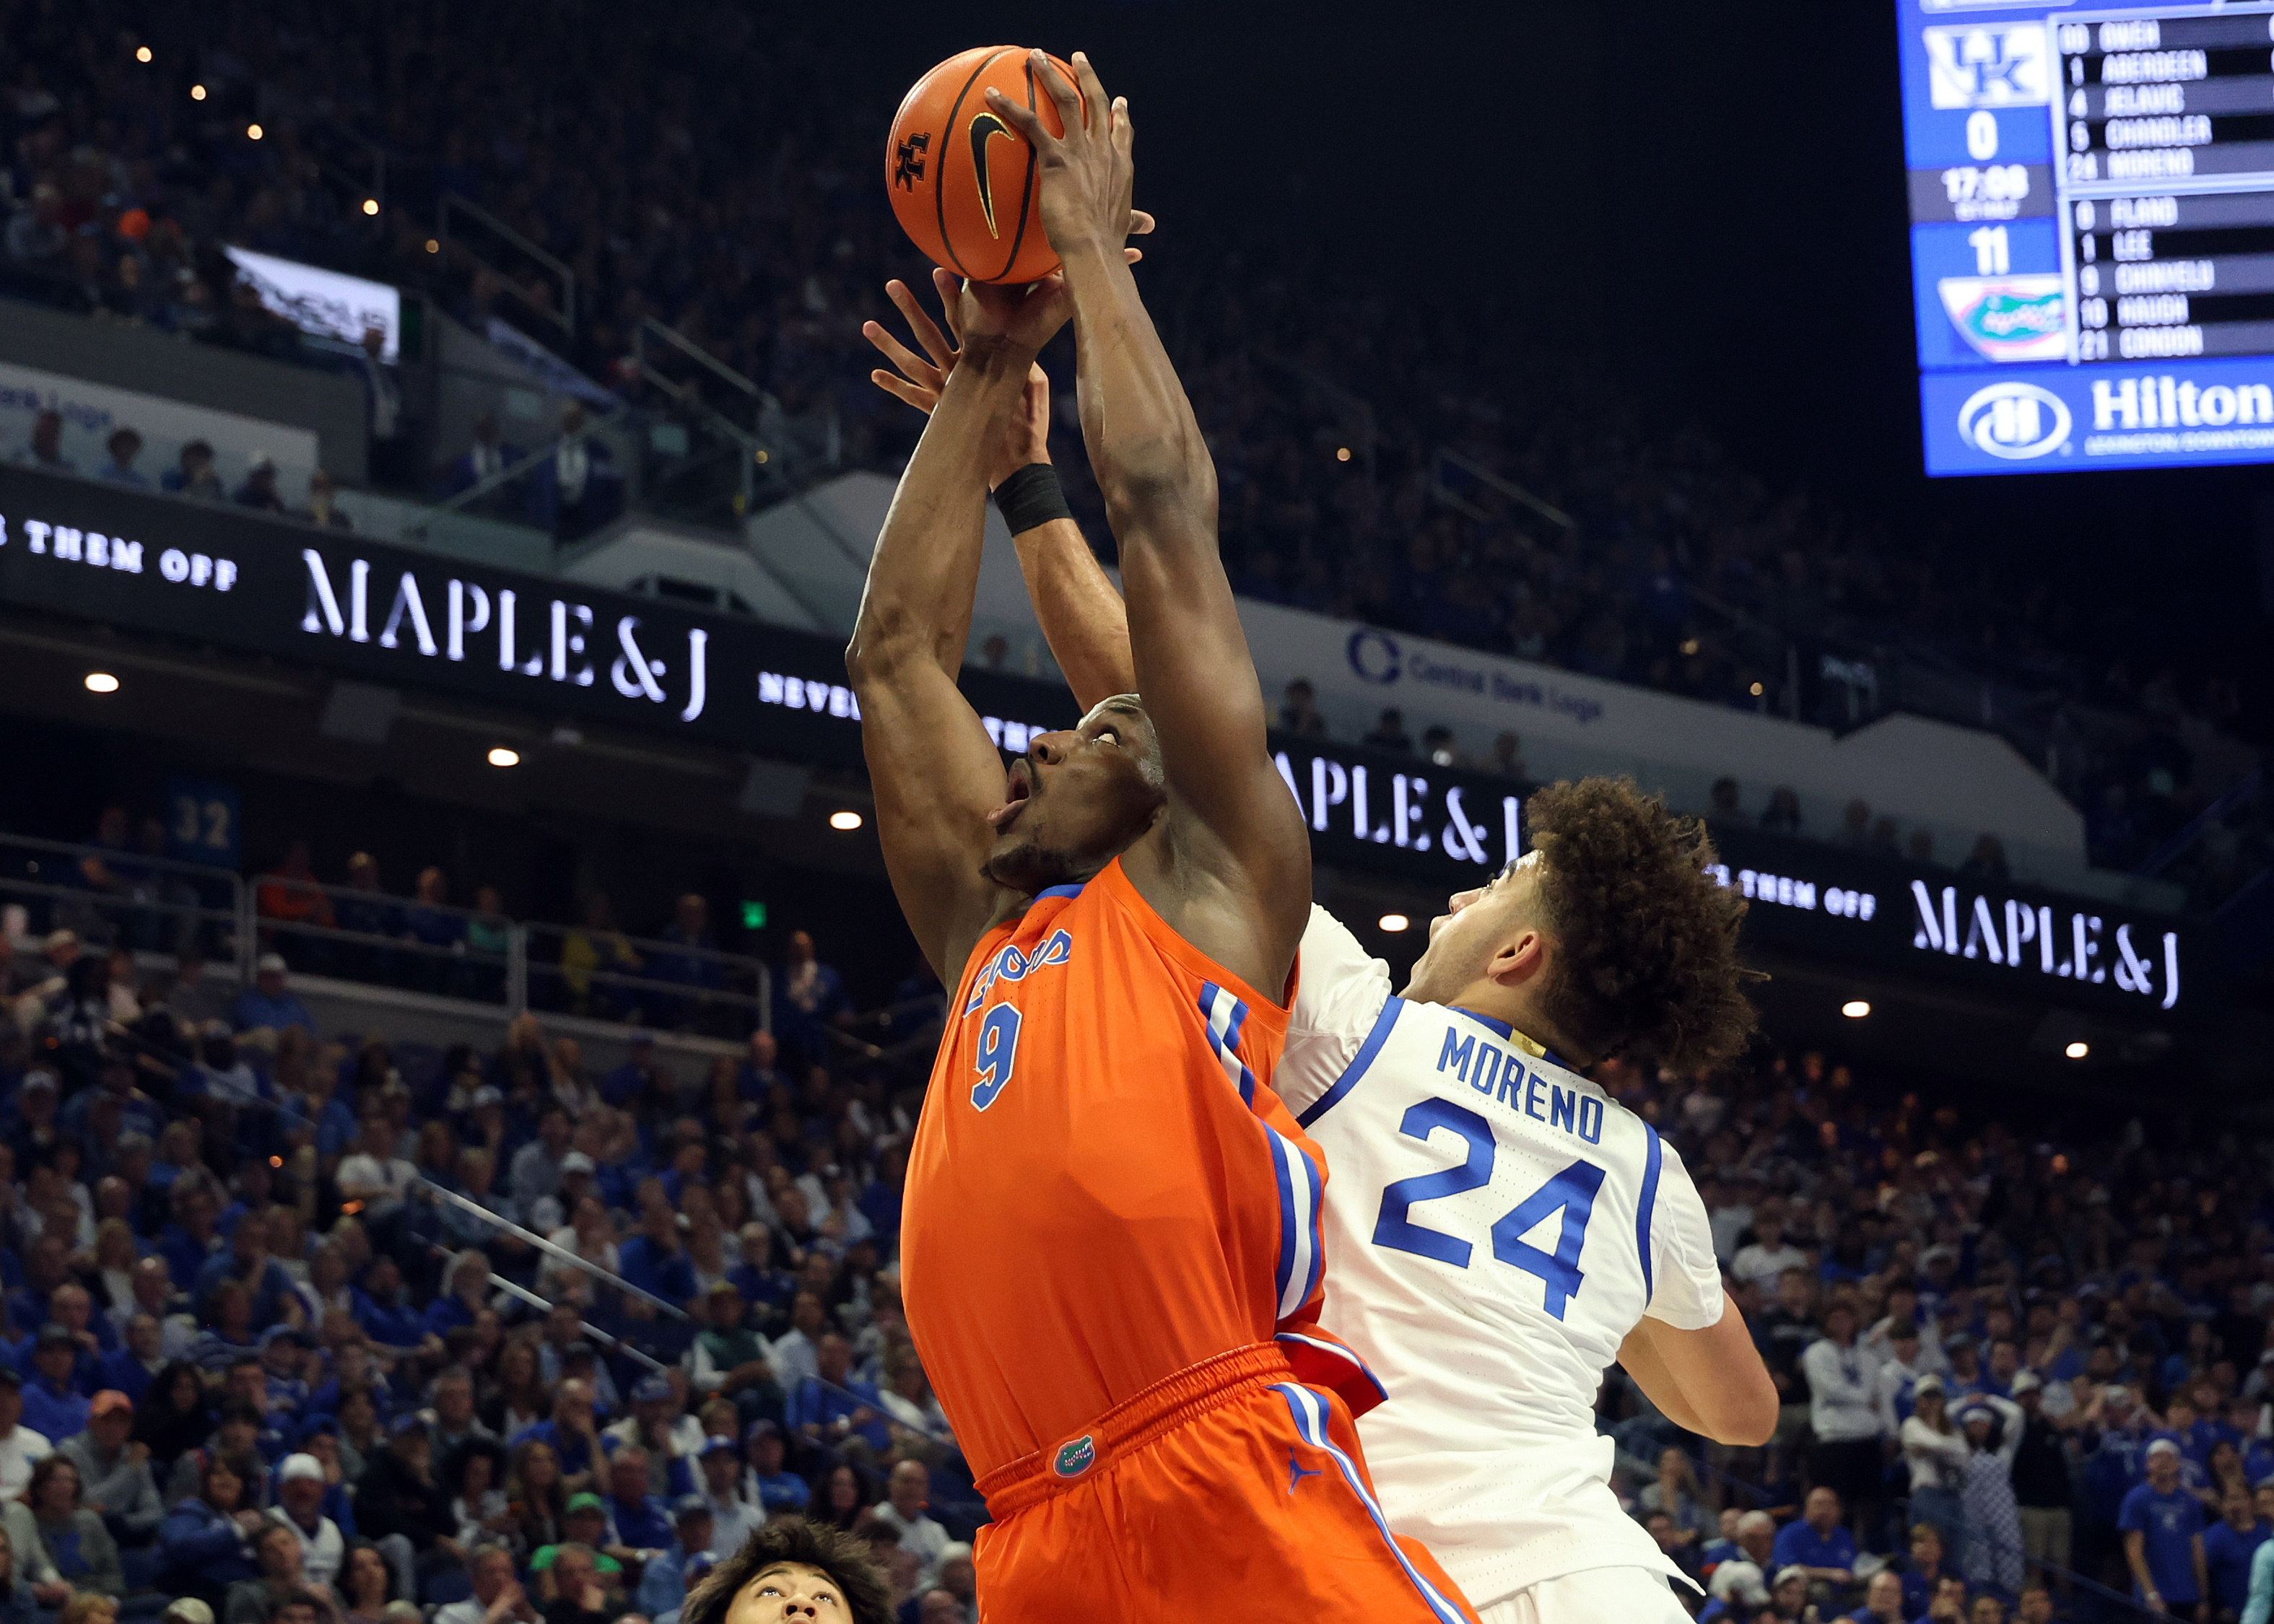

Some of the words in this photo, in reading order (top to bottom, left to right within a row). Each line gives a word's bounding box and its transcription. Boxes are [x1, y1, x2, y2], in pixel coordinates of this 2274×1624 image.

[2070, 56, 2084, 87] 1
[2101, 49, 2208, 85] ABERDEEN
[2069, 88, 2088, 118] 4
[1966, 110, 1999, 160] 0
[2105, 115, 2213, 149] CHANDLER
[2069, 152, 2098, 180] 24
[2107, 147, 2194, 179] MORENO
[1968, 226, 2011, 276] 11
[2081, 232, 2096, 263] 1
[2112, 230, 2154, 261] LEE
[2117, 294, 2190, 327] HAUGH
[2079, 329, 2109, 361] 21
[2091, 375, 2274, 431] Hilton
[23, 519, 144, 573] THEM
[159, 548, 238, 591] OFF
[300, 546, 596, 688] MAPLE
[610, 614, 667, 704] &
[680, 627, 708, 722] J
[1440, 785, 1489, 865] &
[1738, 868, 1817, 910] THEM
[1824, 886, 1876, 922] OFF
[1909, 878, 2107, 985] MAPLE
[2112, 922, 2154, 996] &
[2160, 930, 2180, 1010] J
[970, 1000, 1023, 1113] 9
[1435, 1026, 1604, 1146] MORENO
[1371, 1096, 1607, 1323] 24
